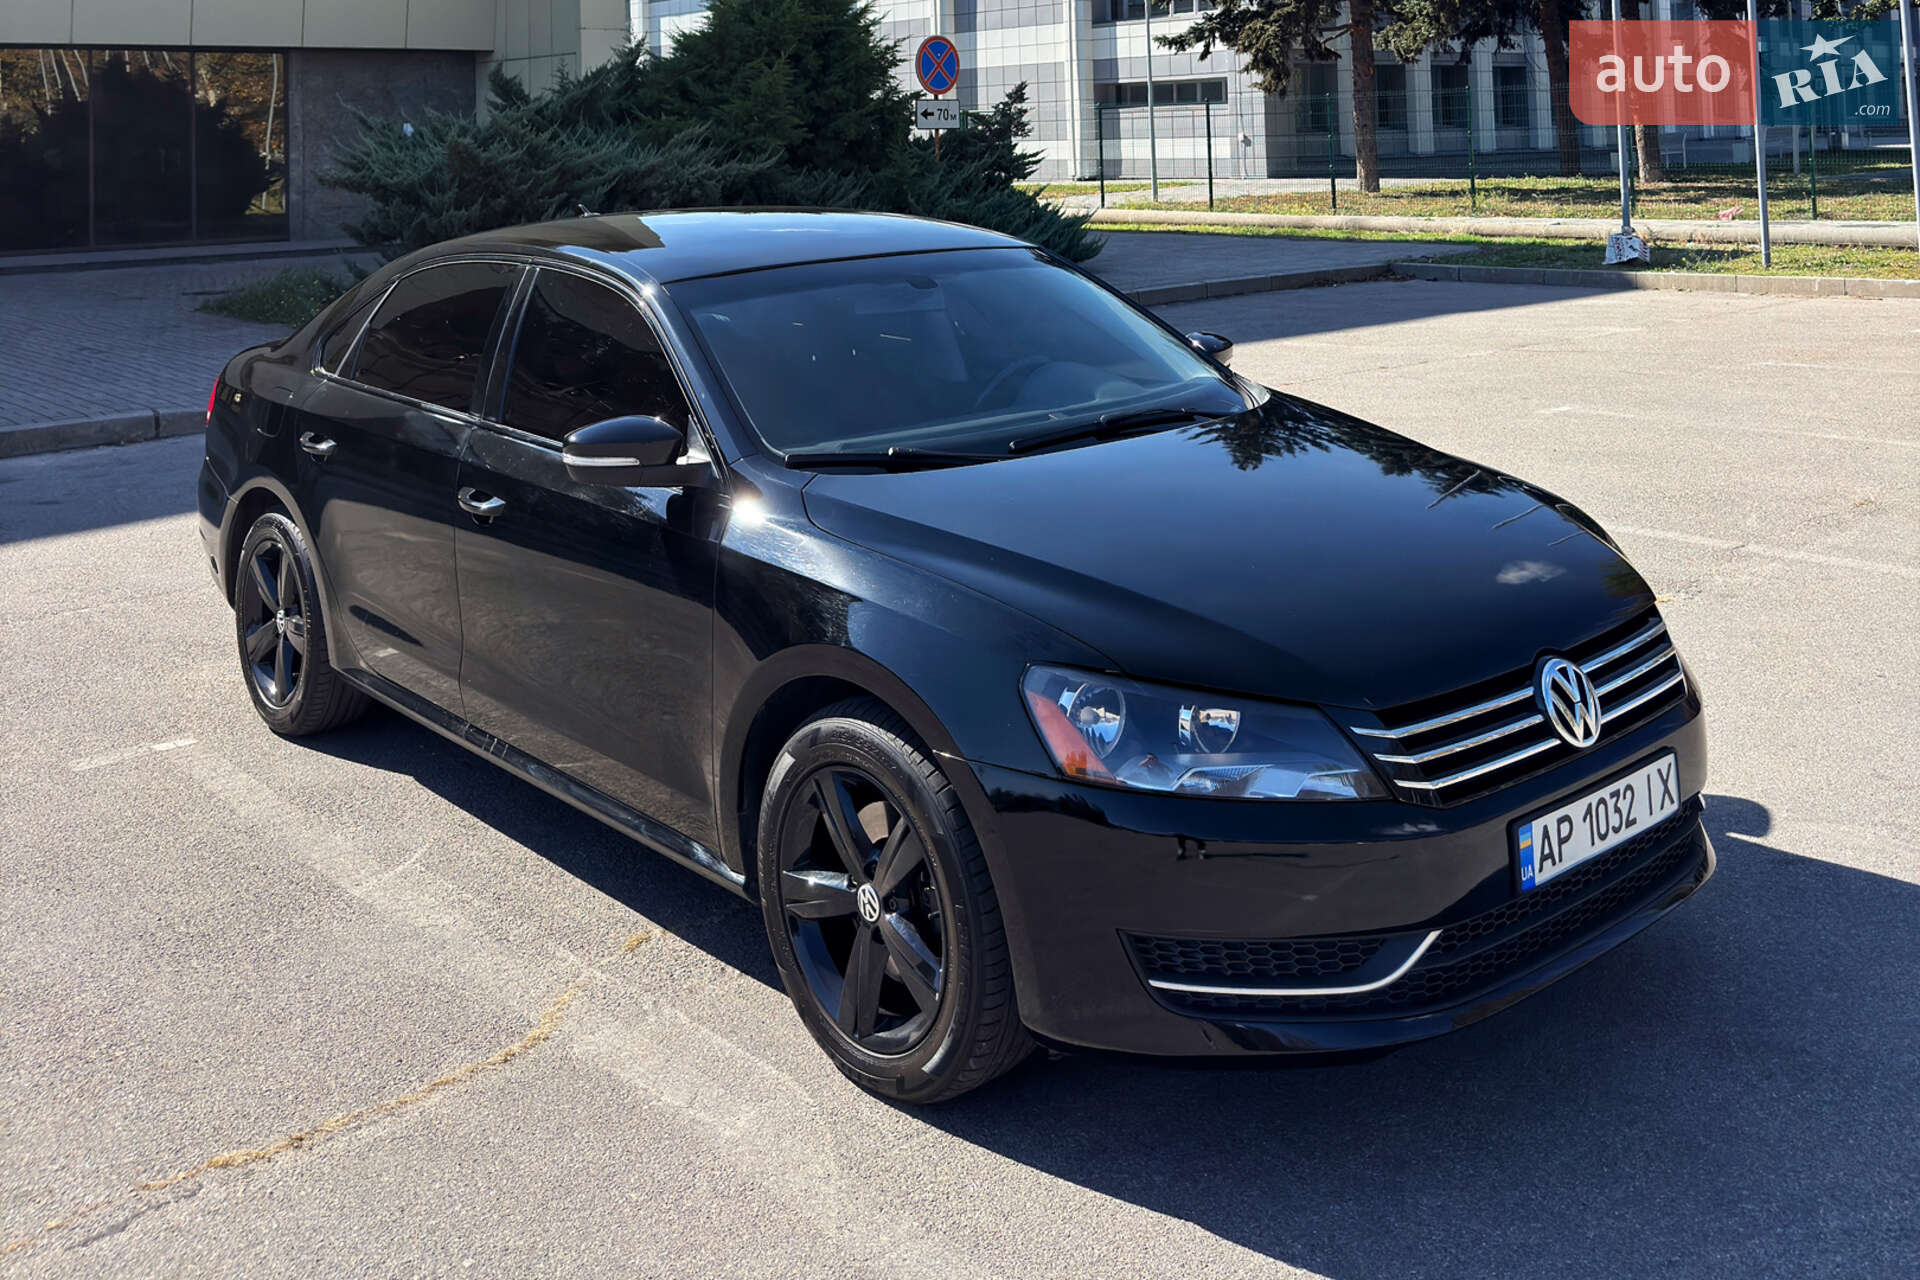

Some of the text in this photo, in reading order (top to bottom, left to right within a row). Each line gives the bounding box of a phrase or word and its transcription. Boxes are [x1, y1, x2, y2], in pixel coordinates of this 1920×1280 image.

[1538, 761, 1676, 874] AP 1032 IX
[1521, 864, 1534, 881] UA
